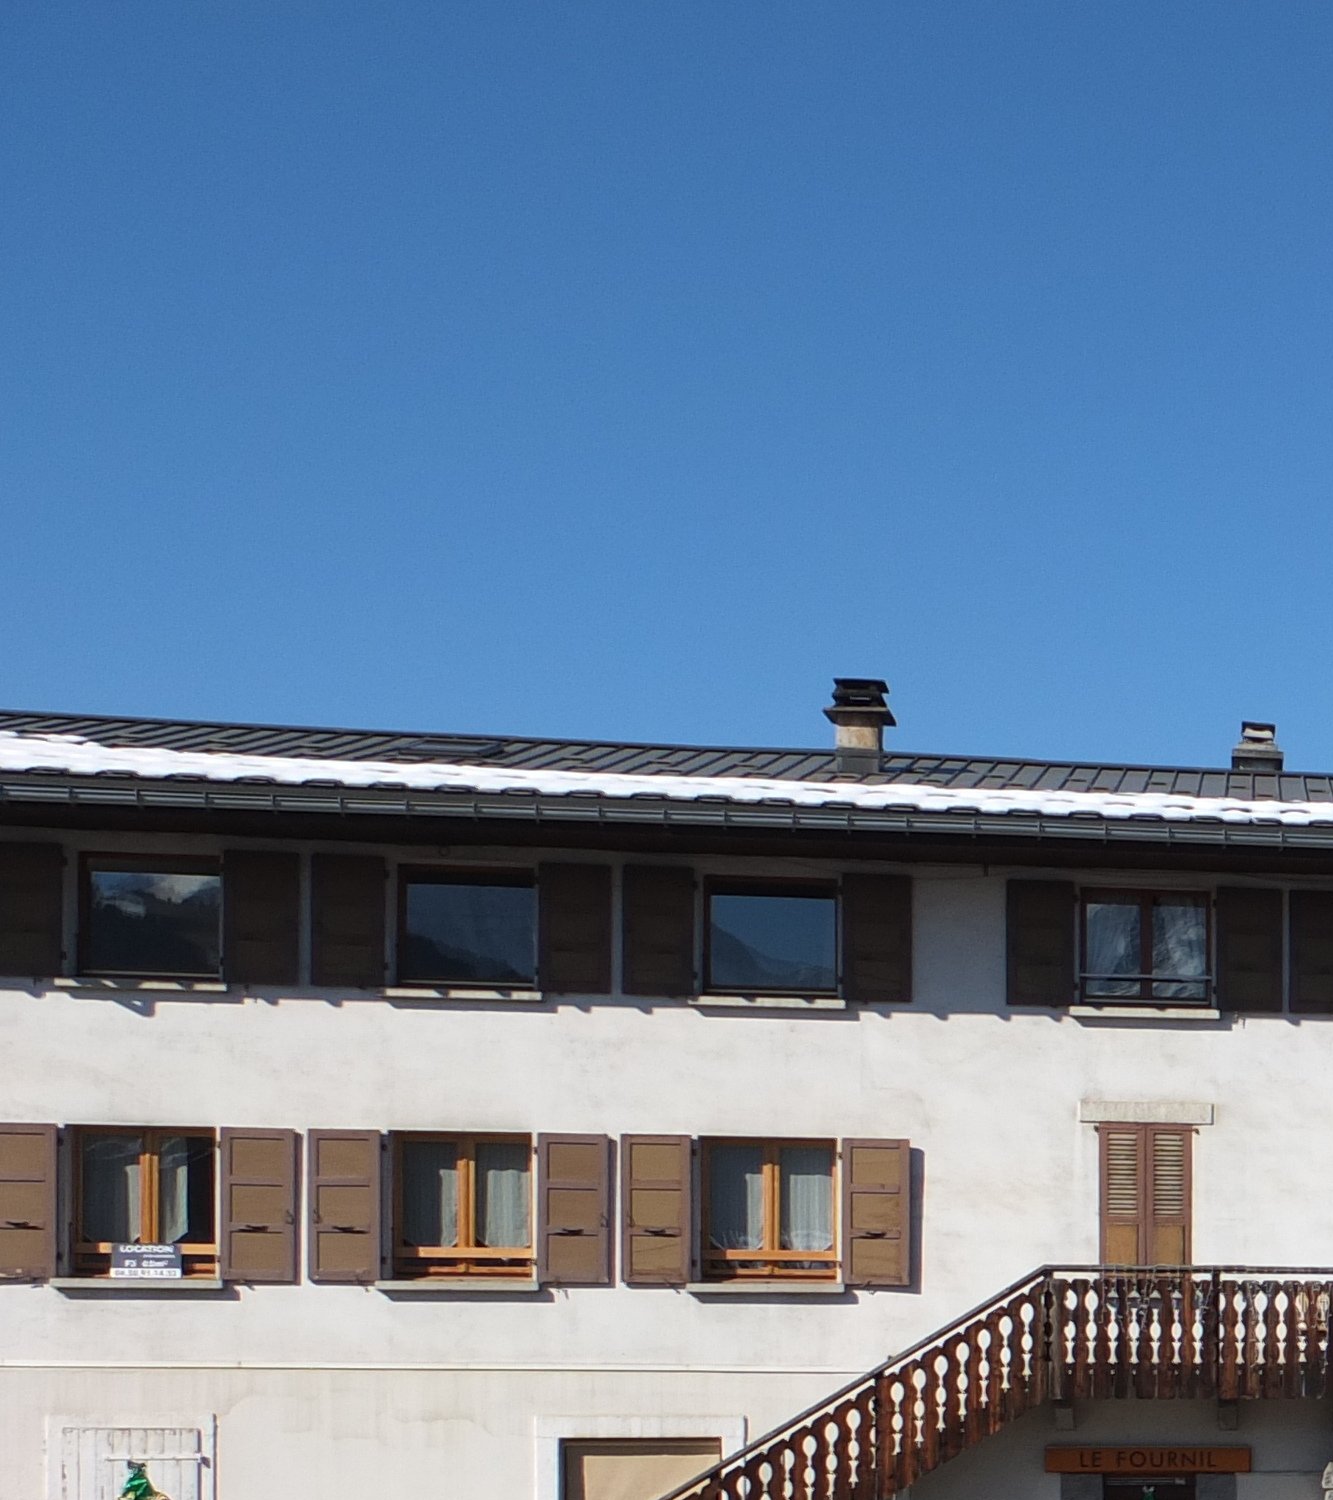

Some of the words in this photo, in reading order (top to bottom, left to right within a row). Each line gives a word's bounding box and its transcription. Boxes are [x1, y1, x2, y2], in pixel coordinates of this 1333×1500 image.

[119, 1244, 175, 1253] LOCATION
[1079, 1451, 1102, 1468] LE
[1116, 1450, 1217, 1468] FOURNIL
